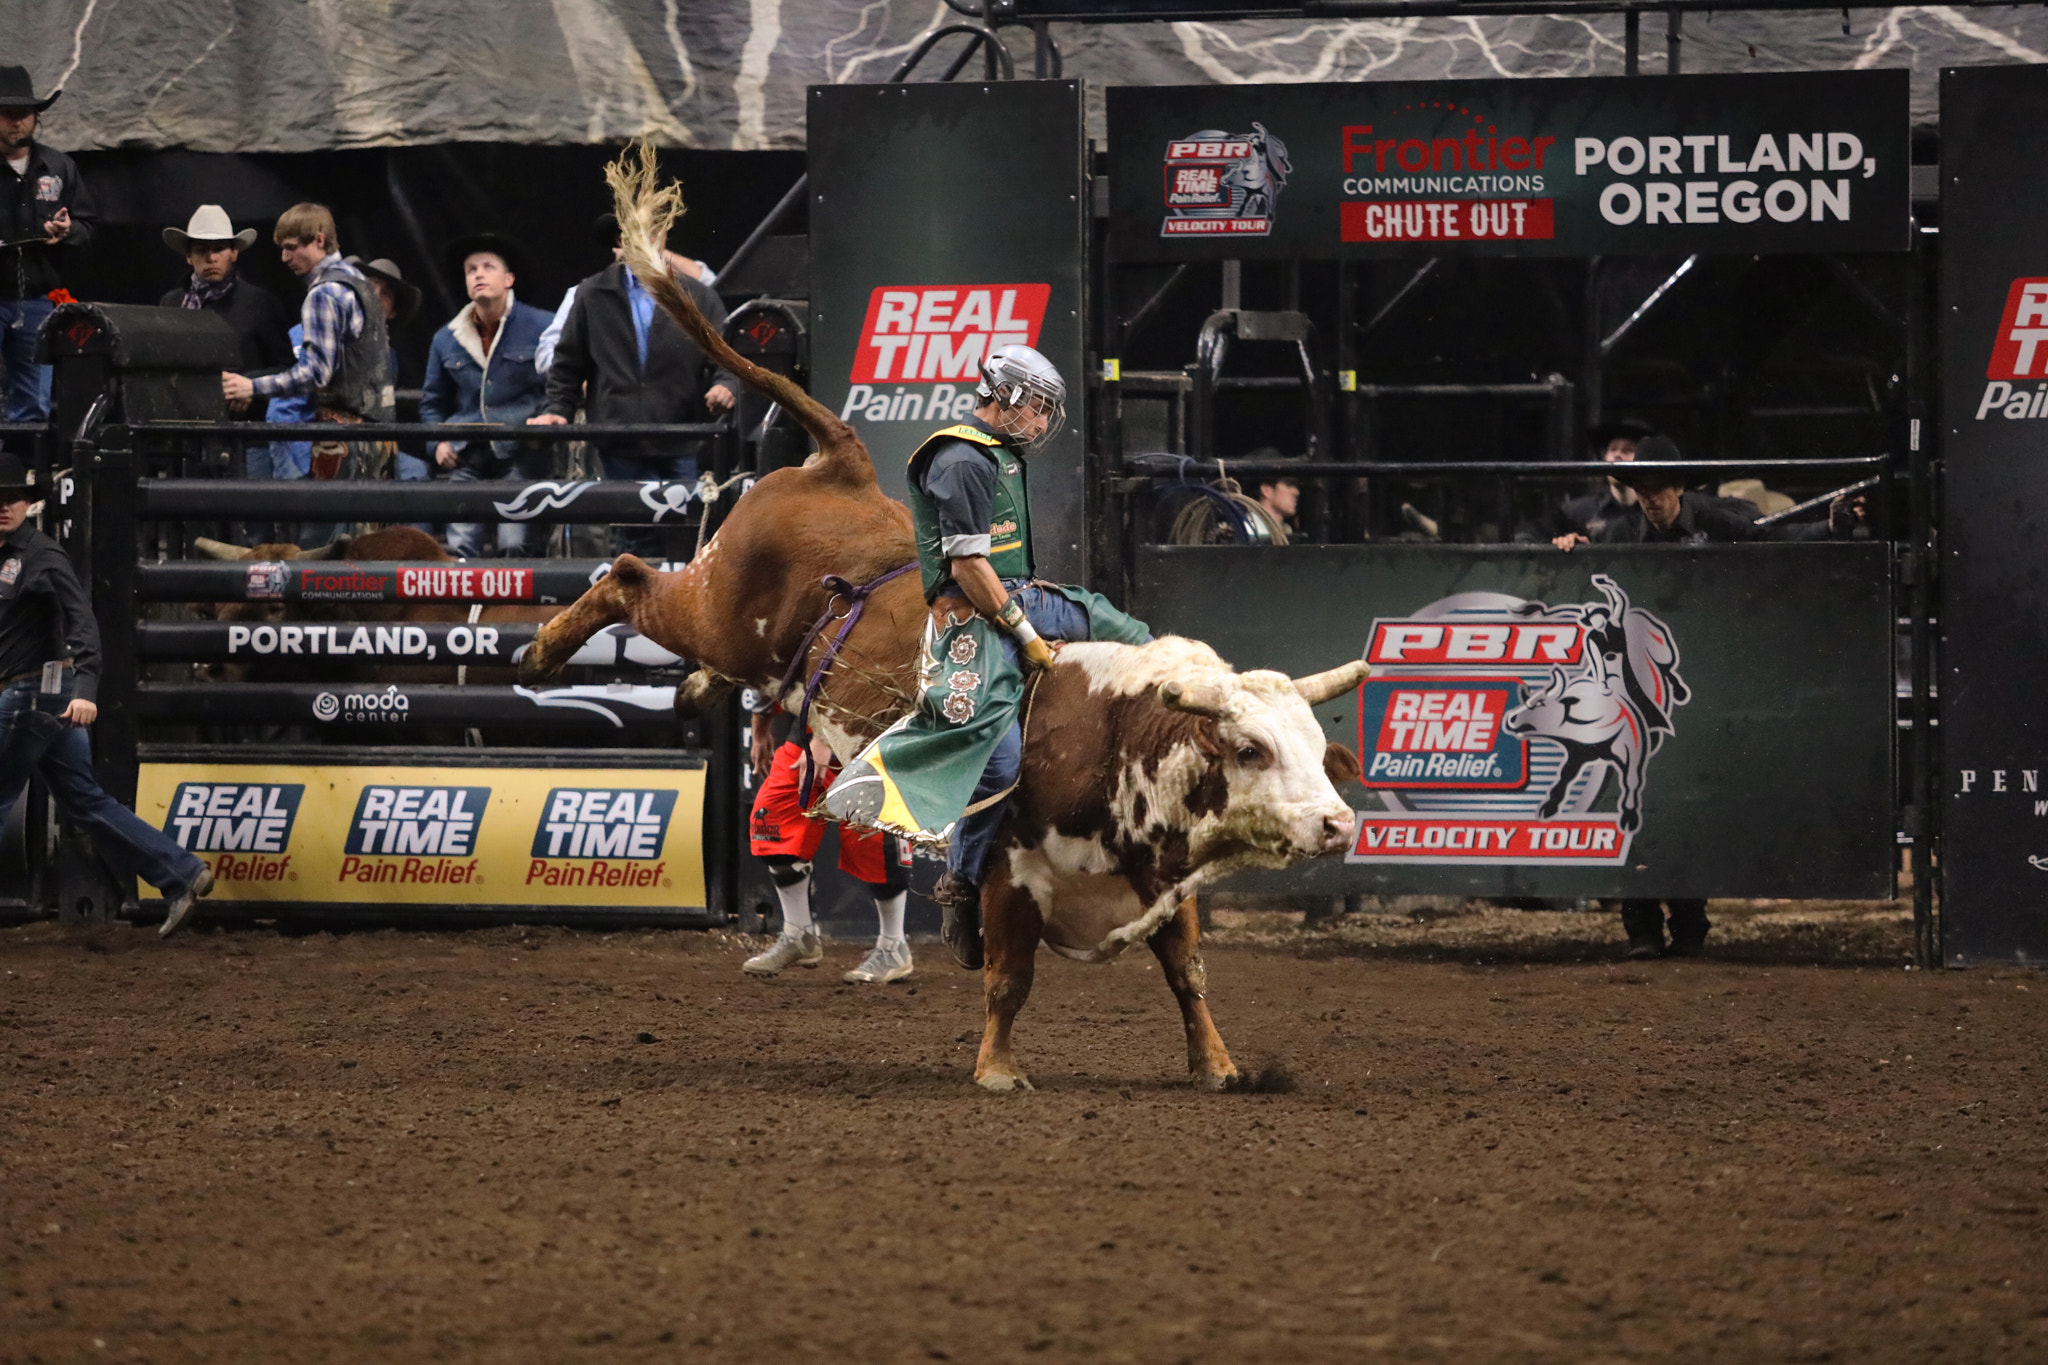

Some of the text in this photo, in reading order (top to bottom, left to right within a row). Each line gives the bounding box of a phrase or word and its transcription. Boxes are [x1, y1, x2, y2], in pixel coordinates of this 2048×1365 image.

[1171, 142, 1250, 158] PBR
[1341, 124, 1556, 173] Frontier
[1574, 132, 1877, 179] PORTLAND,
[1176, 169, 1218, 181] REAL
[1176, 181, 1218, 193] TIME
[1343, 175, 1545, 195] COMMUNICATIONS
[1599, 178, 1850, 226] OREGON
[1167, 220, 1266, 231] VELOCITY TOUR
[1365, 202, 1528, 238] CHUTE OUT
[874, 289, 1029, 333] REAL
[840, 384, 925, 422] Pain
[301, 570, 526, 597] Frontier CHUTE OUT
[301, 591, 384, 600] COMMUNICATIONS
[228, 625, 499, 660] PORTLAND, OR
[1380, 626, 1577, 660] PBR
[345, 686, 409, 710] moda
[1390, 692, 1494, 722] REAL
[345, 710, 409, 722] center
[1390, 720, 1494, 750] TIME
[1369, 752, 1425, 777] Pain
[177, 786, 288, 818] REAL
[362, 788, 474, 821] REAL
[549, 791, 661, 824] REAL
[173, 817, 287, 851] TIME
[359, 820, 473, 854] TIME
[545, 823, 660, 858] TIME
[1365, 826, 1616, 850] VELOCITY TOUR
[338, 856, 398, 883] Pain
[525, 860, 585, 885] Pain
